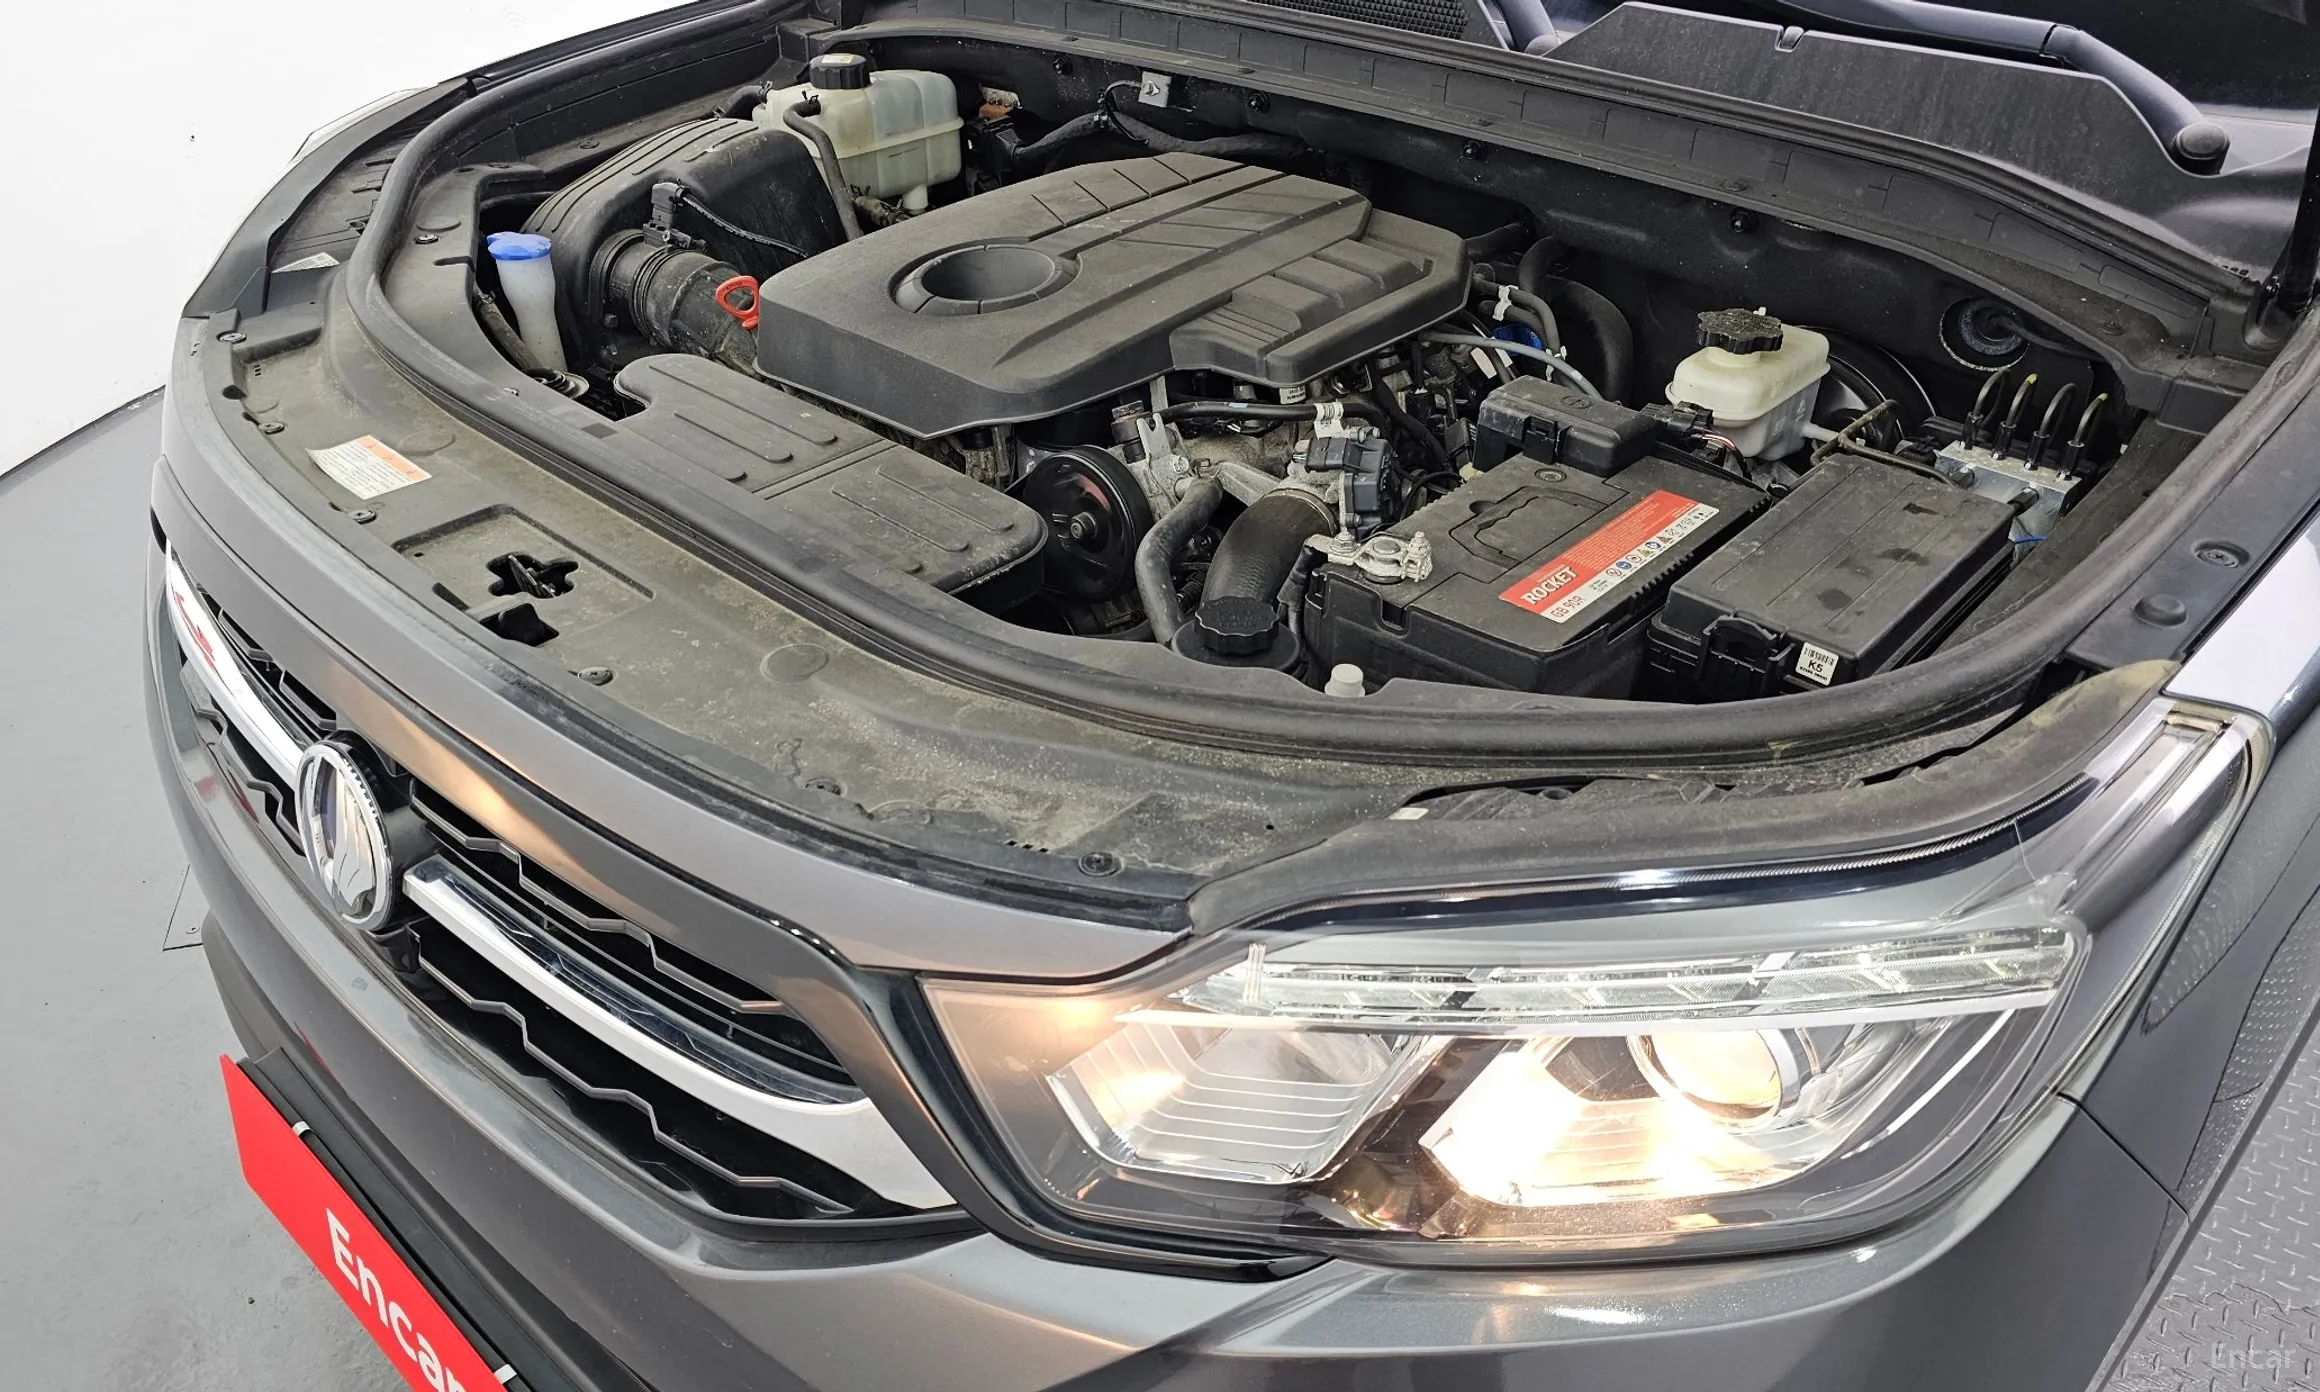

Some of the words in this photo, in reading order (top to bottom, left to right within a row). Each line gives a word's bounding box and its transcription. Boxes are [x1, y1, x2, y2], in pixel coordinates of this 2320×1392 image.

[1520, 566, 1578, 605] ROCKET
[1550, 606, 1569, 618] GB
[1808, 660, 1824, 673] K5
